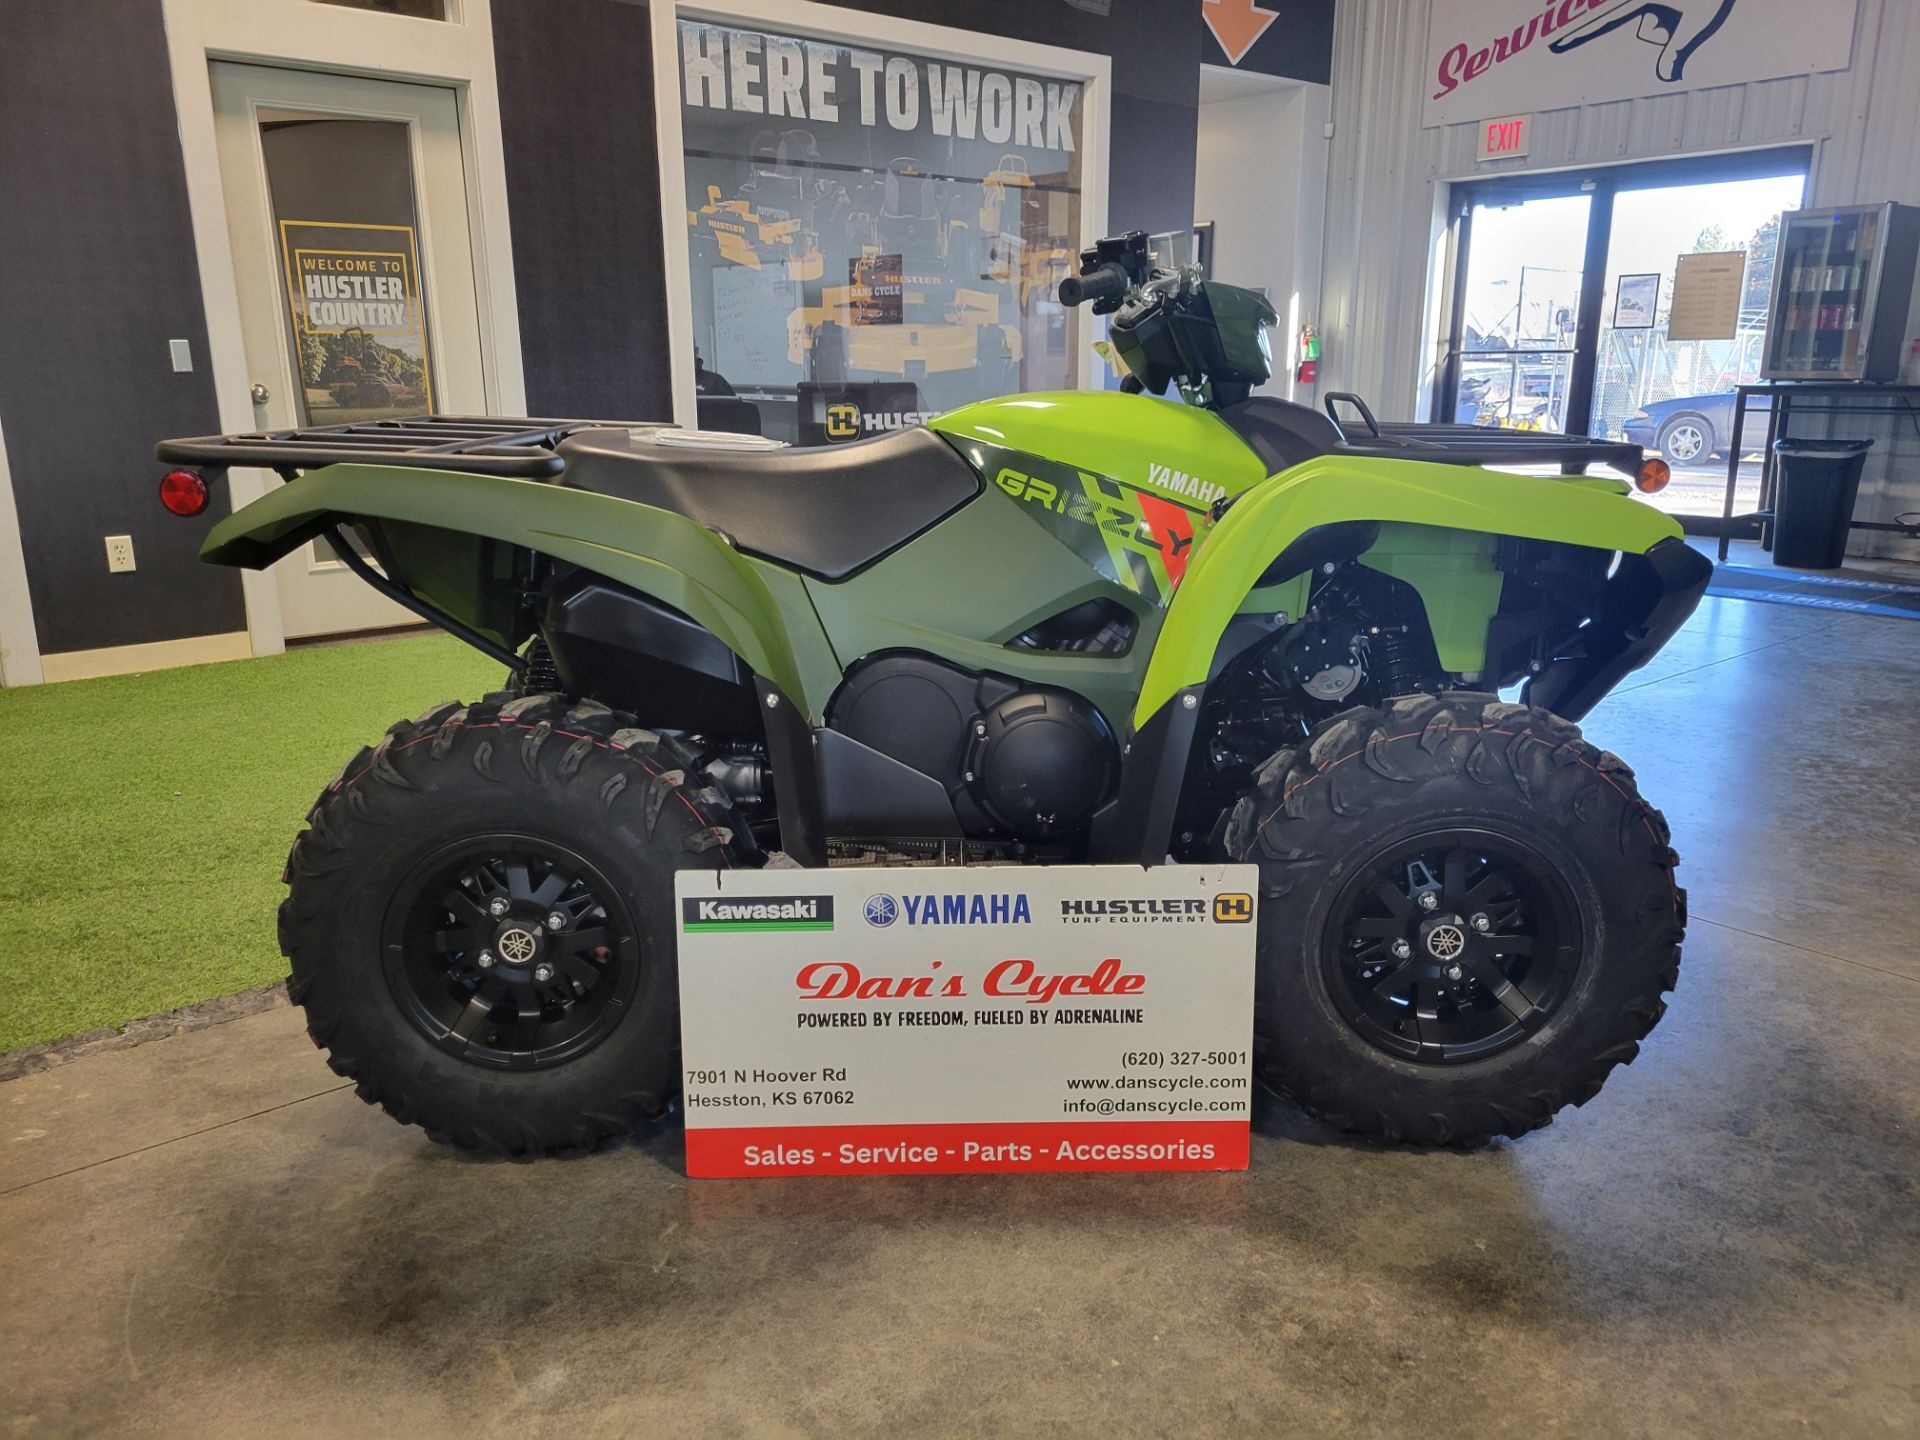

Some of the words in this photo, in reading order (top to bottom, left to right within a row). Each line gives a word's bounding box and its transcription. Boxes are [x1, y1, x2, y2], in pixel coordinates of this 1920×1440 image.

[1432, 0, 1606, 100] Servic
[682, 20, 839, 123] HERE
[850, 50, 920, 132] TO
[927, 62, 1080, 153] WORK
[1486, 120, 1523, 153] EXIT
[303, 258, 377, 273] WELCOME
[382, 261, 401, 273] TO
[305, 274, 404, 300] HUSTLER
[885, 274, 942, 285] HUSTLER
[850, 287, 873, 297] DANS
[874, 285, 901, 297] CYCLE
[309, 301, 405, 326] COUNTRY
[863, 411, 942, 431] HUST
[1147, 462, 1228, 503] YAMAHA
[995, 467, 1193, 558] GRIZZLY
[699, 899, 817, 921] Kawasaki
[901, 894, 1032, 925] YAMAHA
[1061, 899, 1207, 915] HUSTLER
[1061, 916, 1102, 925] TURF
[1109, 915, 1207, 924] EQUIPMENT
[796, 960, 968, 1000] Dan's
[982, 958, 1147, 1004] Cycle
[797, 1012, 867, 1028] POWERED
[873, 1012, 892, 1027] BY
[898, 1011, 968, 1027] FREEDOM,
[974, 1010, 1024, 1025] FUELED
[1029, 1010, 1049, 1025] BY
[1053, 1009, 1144, 1024] ADRENALINE
[1121, 1052, 1165, 1069] (620)
[1170, 1051, 1247, 1066] 327-5001
[687, 1070, 727, 1084] 7901
[734, 1070, 747, 1084] N
[753, 1069, 817, 1083] Hoover
[822, 1068, 847, 1082] Rd
[1066, 1075, 1247, 1092] www.danscycle.com
[688, 1093, 766, 1108] Hesston,
[772, 1092, 797, 1106] KS
[803, 1091, 855, 1105] 67062
[1063, 1098, 1246, 1115] info@danscycle.com
[744, 1143, 815, 1166] Sales
[839, 1142, 938, 1164] Service
[963, 1141, 1032, 1162] Parts
[1055, 1138, 1216, 1161] Accessories
